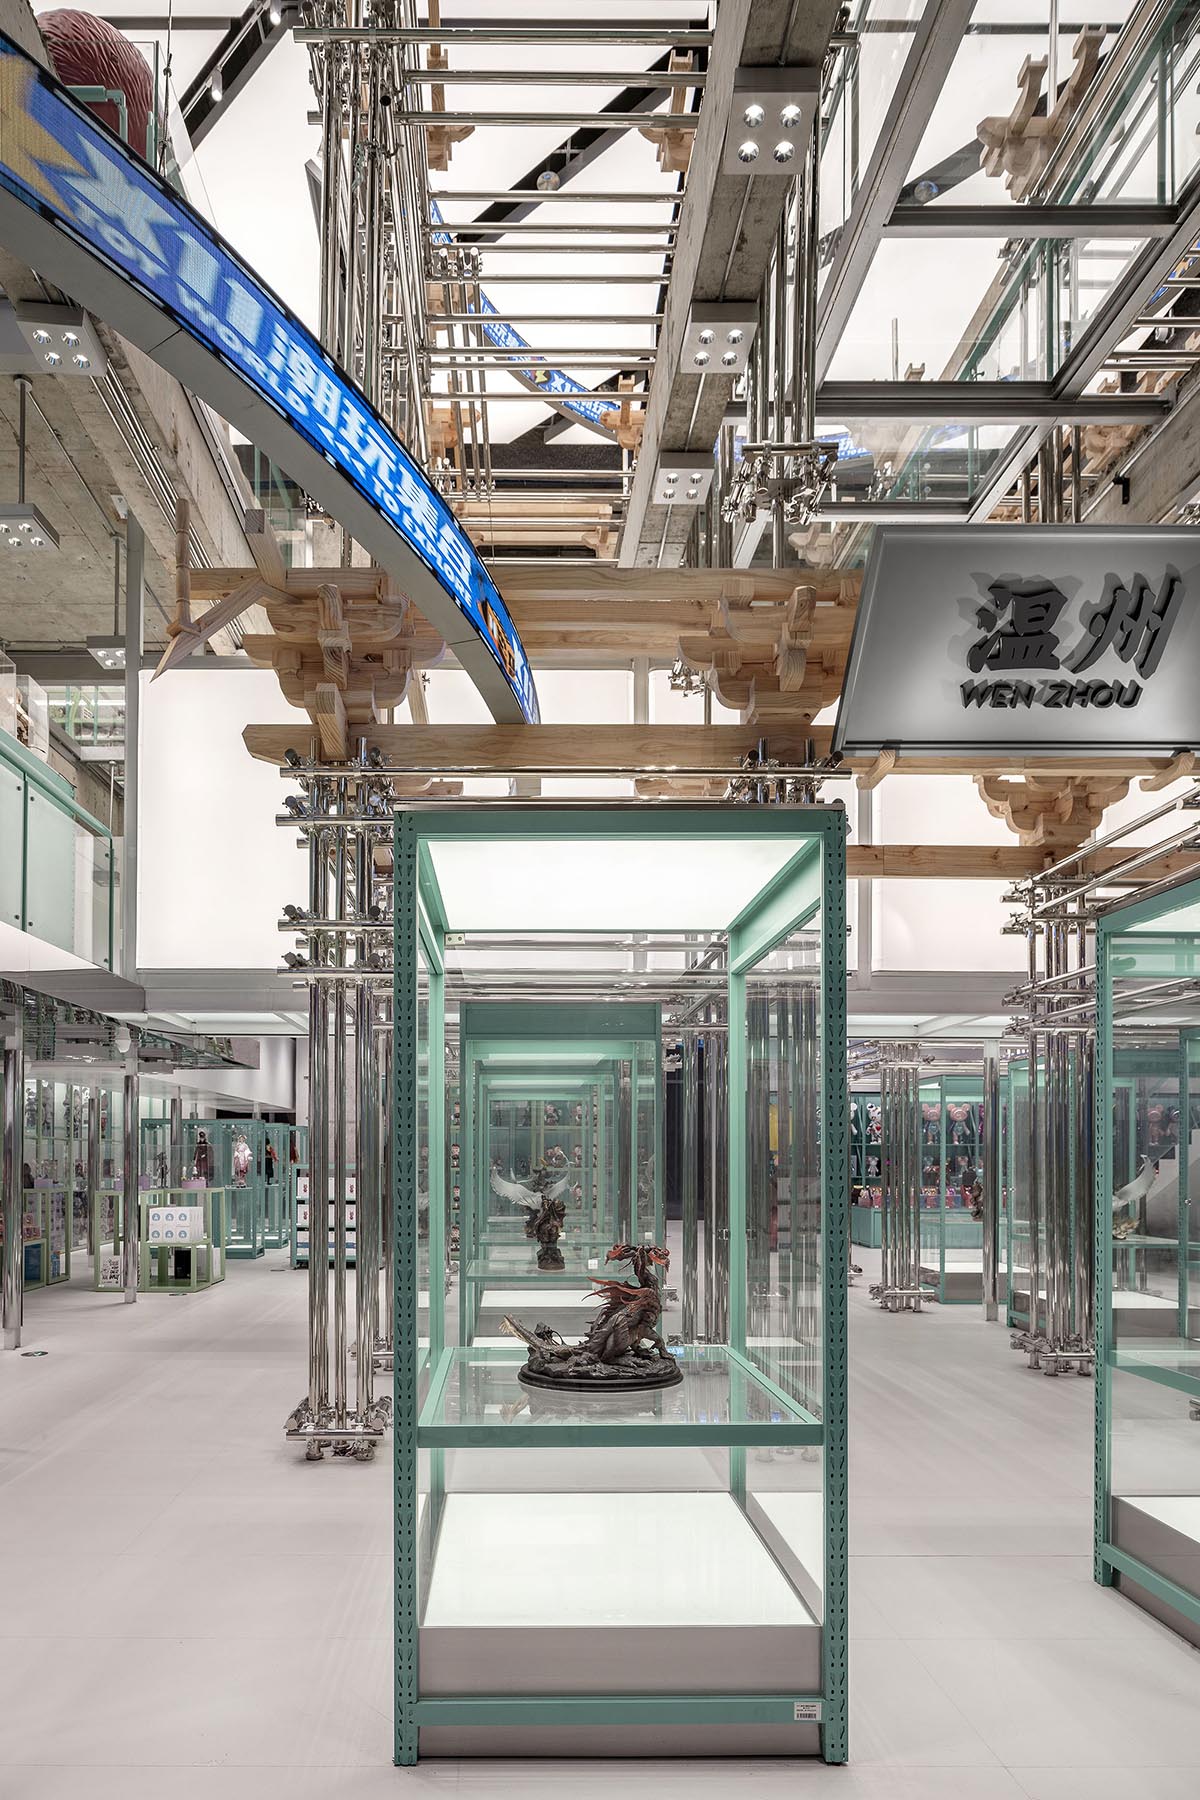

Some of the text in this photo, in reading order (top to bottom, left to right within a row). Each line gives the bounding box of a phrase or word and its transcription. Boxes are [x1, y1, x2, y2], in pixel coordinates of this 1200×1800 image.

[71, 195, 472, 608] TOY WORLD TO EXPLORE
[964, 566, 1186, 680] 温州
[960, 679, 1144, 709] WEN ZHOU
